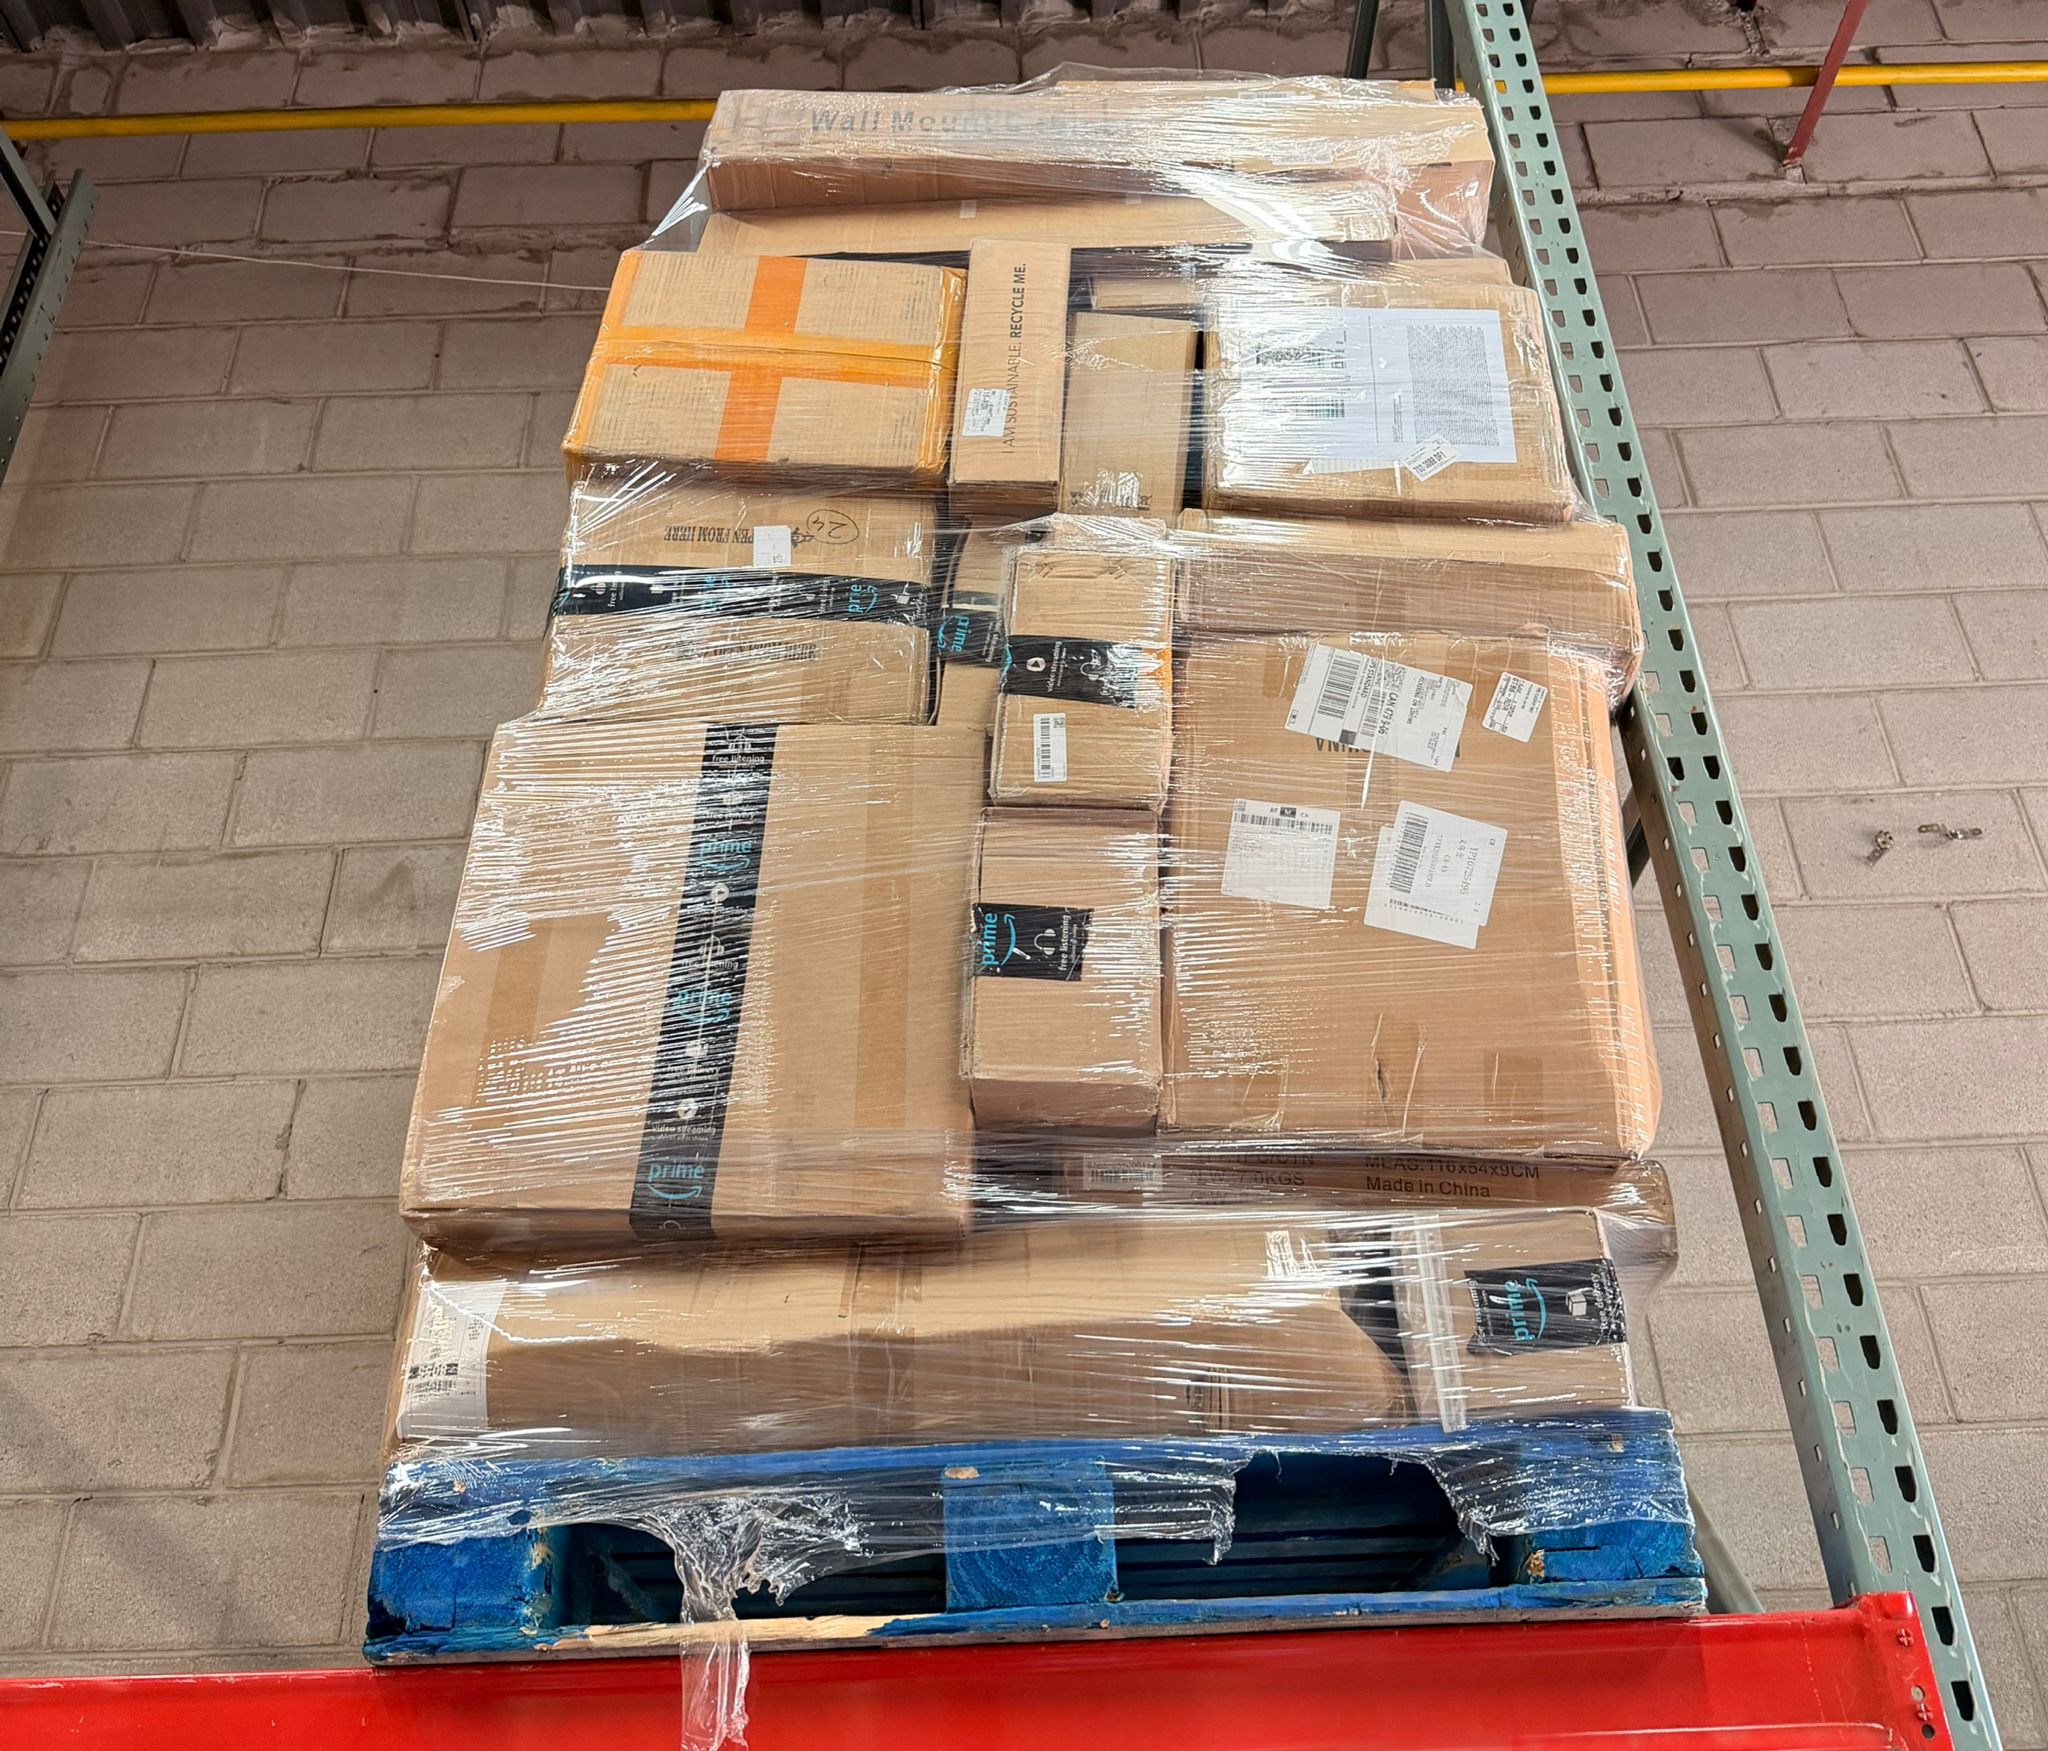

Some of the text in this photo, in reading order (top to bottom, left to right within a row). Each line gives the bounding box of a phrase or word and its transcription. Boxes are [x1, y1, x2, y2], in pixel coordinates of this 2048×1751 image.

[812, 110, 879, 131] Wall
[1013, 263, 1027, 285] ME.
[1009, 287, 1025, 338] RECYCLE
[1003, 424, 1016, 448] AM
[663, 525, 754, 544] PEN FROM HERE
[980, 913, 1000, 966] prime
[1058, 914, 1072, 971] free listening
[648, 1160, 705, 1183] prime
[1366, 1175, 1491, 1198] Made in China
[1505, 1279, 1535, 1341] prime
